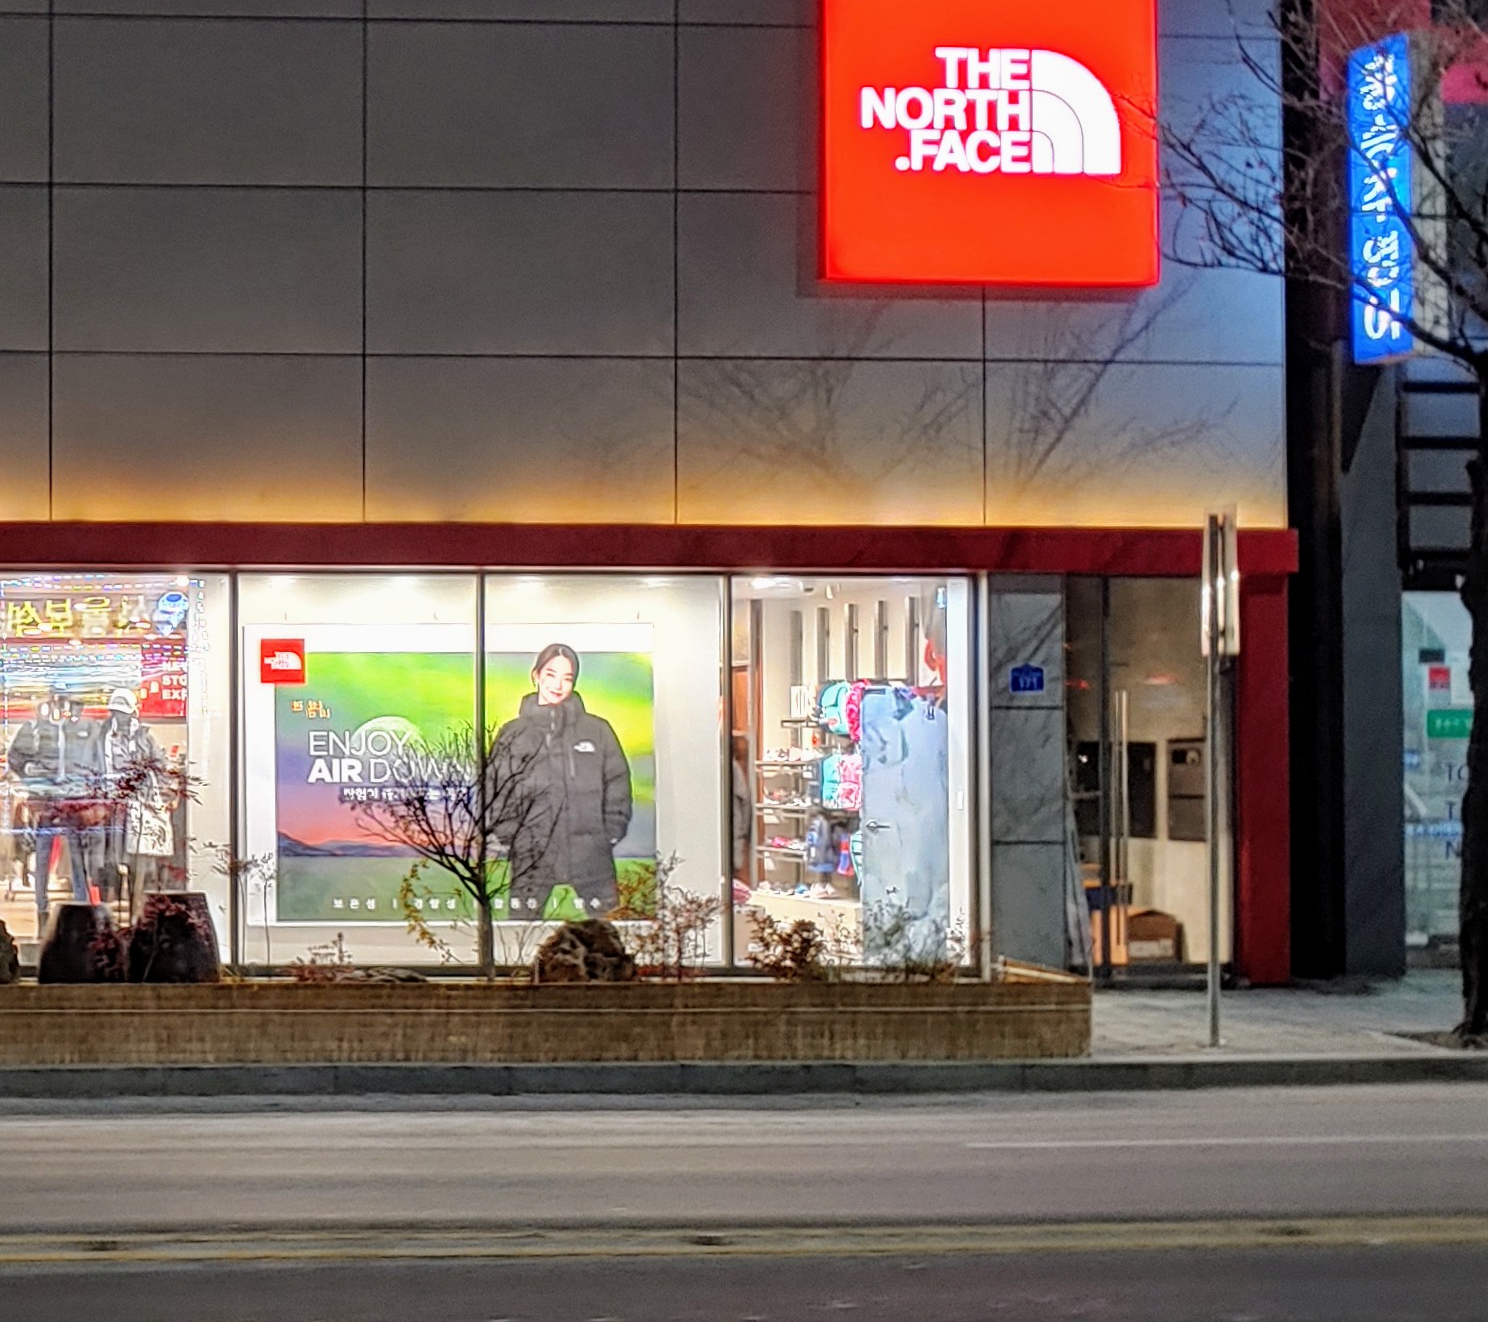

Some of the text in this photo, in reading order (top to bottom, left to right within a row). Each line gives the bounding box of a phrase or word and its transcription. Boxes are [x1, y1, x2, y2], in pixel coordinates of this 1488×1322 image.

[934, 46, 1031, 90] THE
[860, 86, 1032, 131] NORTH
[910, 128, 1032, 174] FACE
[308, 730, 412, 757] ENJOY
[307, 758, 363, 784] AIR
